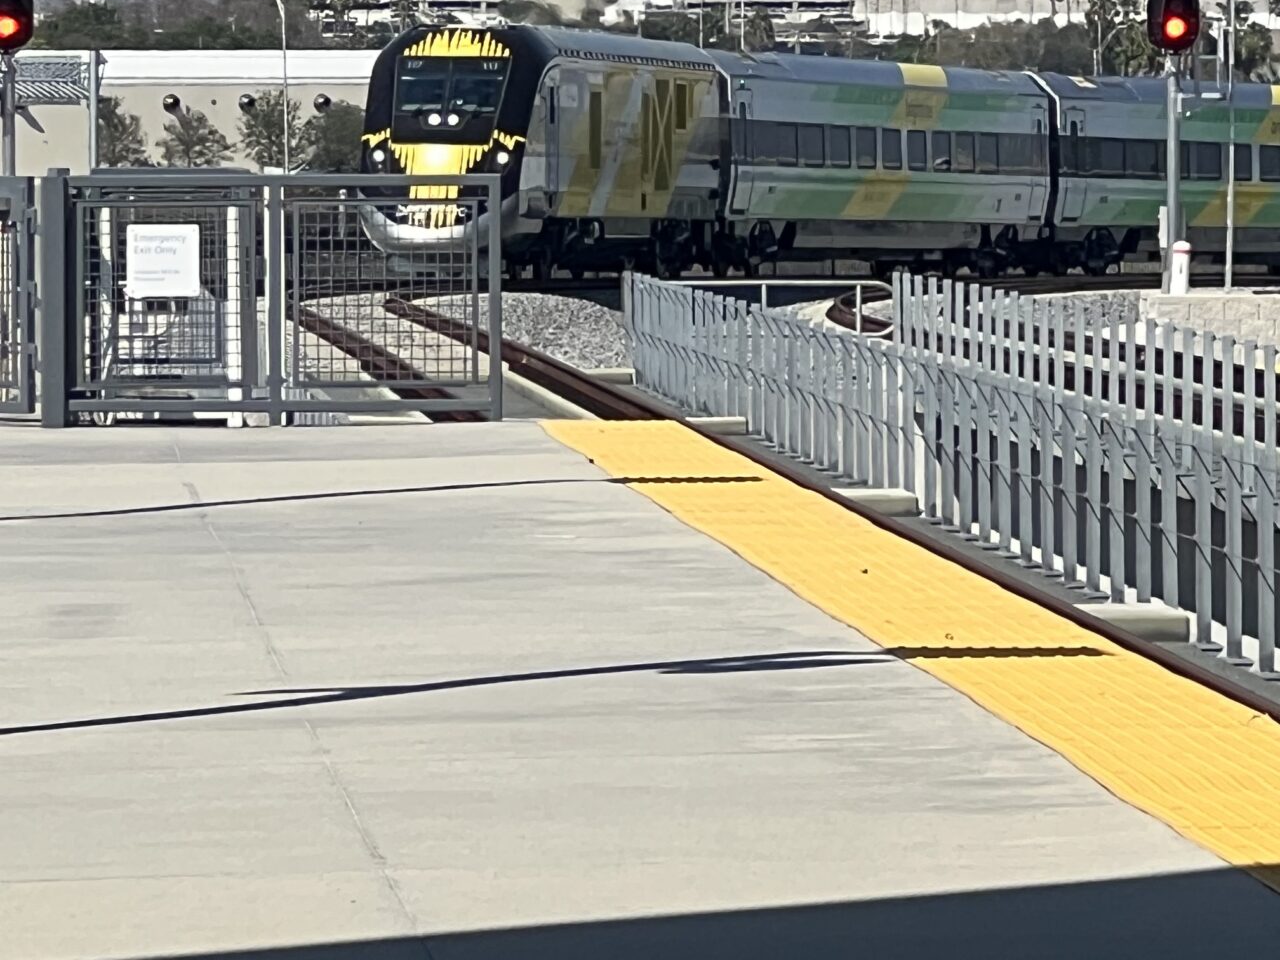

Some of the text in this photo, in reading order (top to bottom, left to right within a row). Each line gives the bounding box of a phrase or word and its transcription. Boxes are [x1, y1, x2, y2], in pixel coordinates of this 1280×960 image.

[133, 233, 187, 244] Emergency
[133, 245, 177, 256] Exit Only
